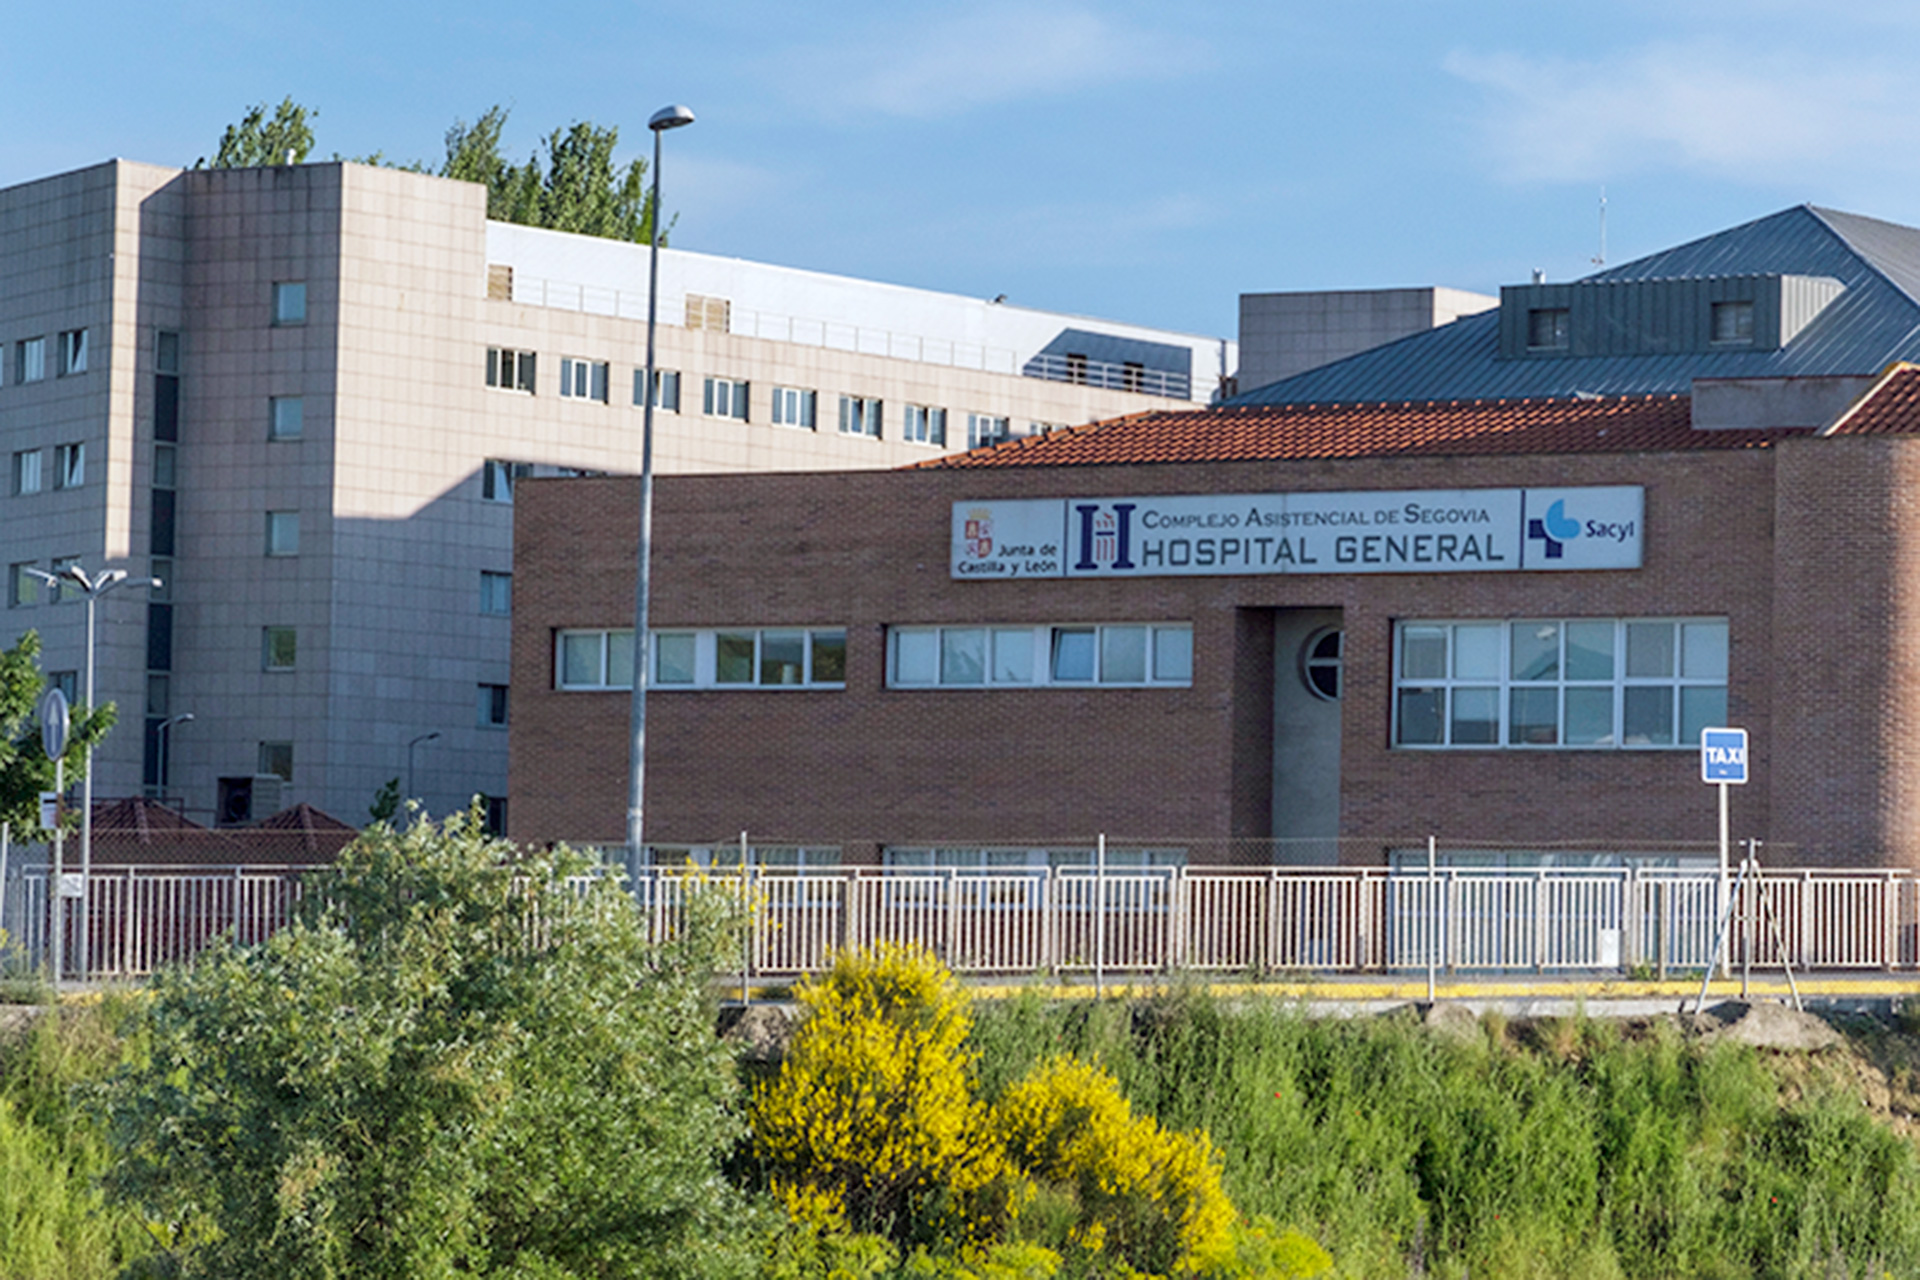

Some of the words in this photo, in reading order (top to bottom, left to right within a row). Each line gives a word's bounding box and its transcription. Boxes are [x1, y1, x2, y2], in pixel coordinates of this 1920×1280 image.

[1374, 510, 1399, 524] DE
[1586, 519, 1635, 543] Sacyl
[998, 544, 1035, 557] Junta
[1039, 543, 1057, 556] de
[1142, 537, 1318, 567] HOSPITAL
[1335, 534, 1504, 563] GENERAL
[958, 560, 1005, 575] Castilla
[1011, 562, 1020, 576] y
[1025, 559, 1058, 573] León
[1706, 747, 1744, 764] TAXI
